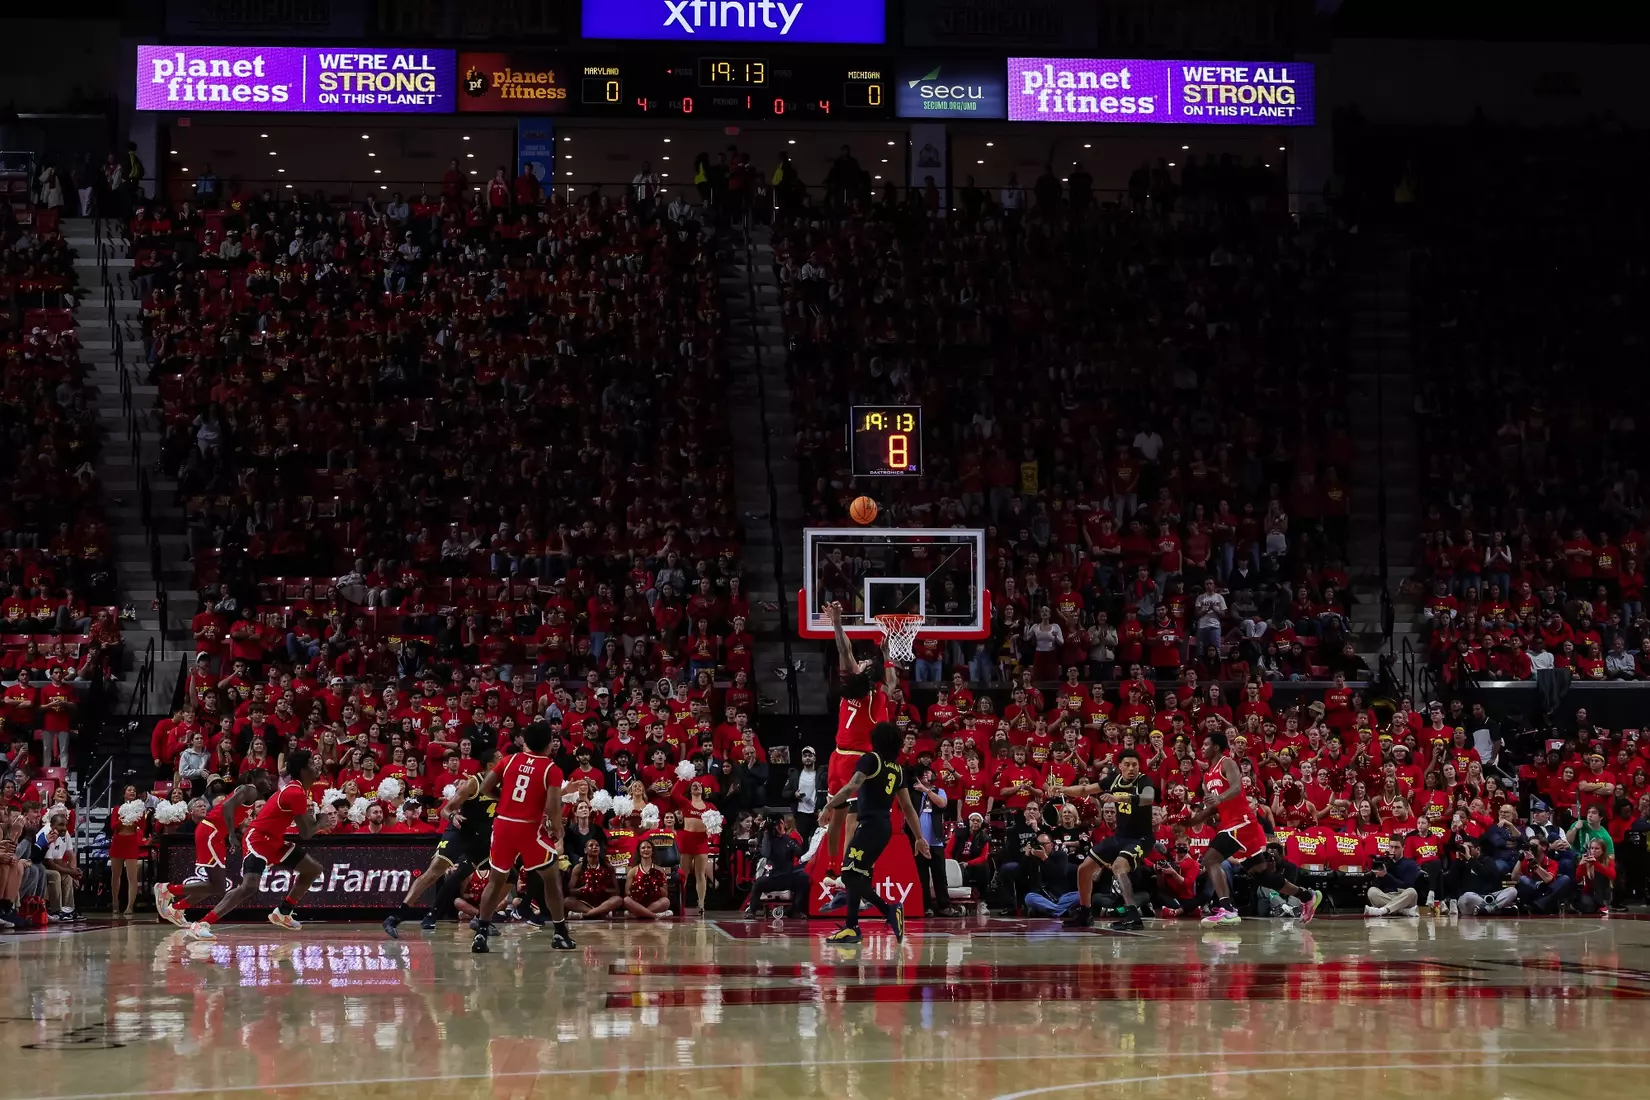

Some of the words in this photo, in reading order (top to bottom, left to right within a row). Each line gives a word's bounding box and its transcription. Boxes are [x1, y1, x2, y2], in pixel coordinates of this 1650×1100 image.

[663, 0, 804, 35] xfinity
[152, 53, 265, 83] planet
[318, 54, 388, 70] WE'RE
[391, 55, 435, 70] ALL
[584, 67, 619, 75] MARYLAND
[492, 68, 555, 88] planet
[711, 62, 764, 83] 19:13
[848, 71, 880, 79] MICHIGAN
[1021, 65, 1131, 95] planet
[1182, 66, 1250, 83] WE'RE
[1253, 67, 1295, 84] ALL
[168, 77, 290, 102] fitness
[318, 72, 436, 92] STRONG
[501, 83, 567, 99] fitness
[318, 94, 339, 104] ON
[341, 94, 376, 104] THIS
[377, 94, 434, 105] PLANET
[606, 81, 619, 102] 0
[868, 85, 880, 105] 0
[1183, 84, 1296, 105] STRONG
[637, 98, 647, 111] 4
[682, 97, 693, 113] 0
[774, 99, 784, 114] 0
[819, 100, 830, 114] 4
[1037, 90, 1155, 114] fitness
[1183, 105, 1203, 116] ON
[1205, 105, 1238, 117] THIS
[1239, 106, 1294, 118] PLANET
[866, 413, 913, 432] 19:13
[888, 434, 908, 468] 8
[844, 705, 858, 729] 7
[518, 764, 535, 774] COIT
[511, 774, 531, 803] 8
[885, 772, 897, 796] 3
[486, 802, 497, 817] 4
[1295, 835, 1320, 845] TERPS
[1334, 835, 1359, 846] TERPS
[848, 846, 864, 861] M
